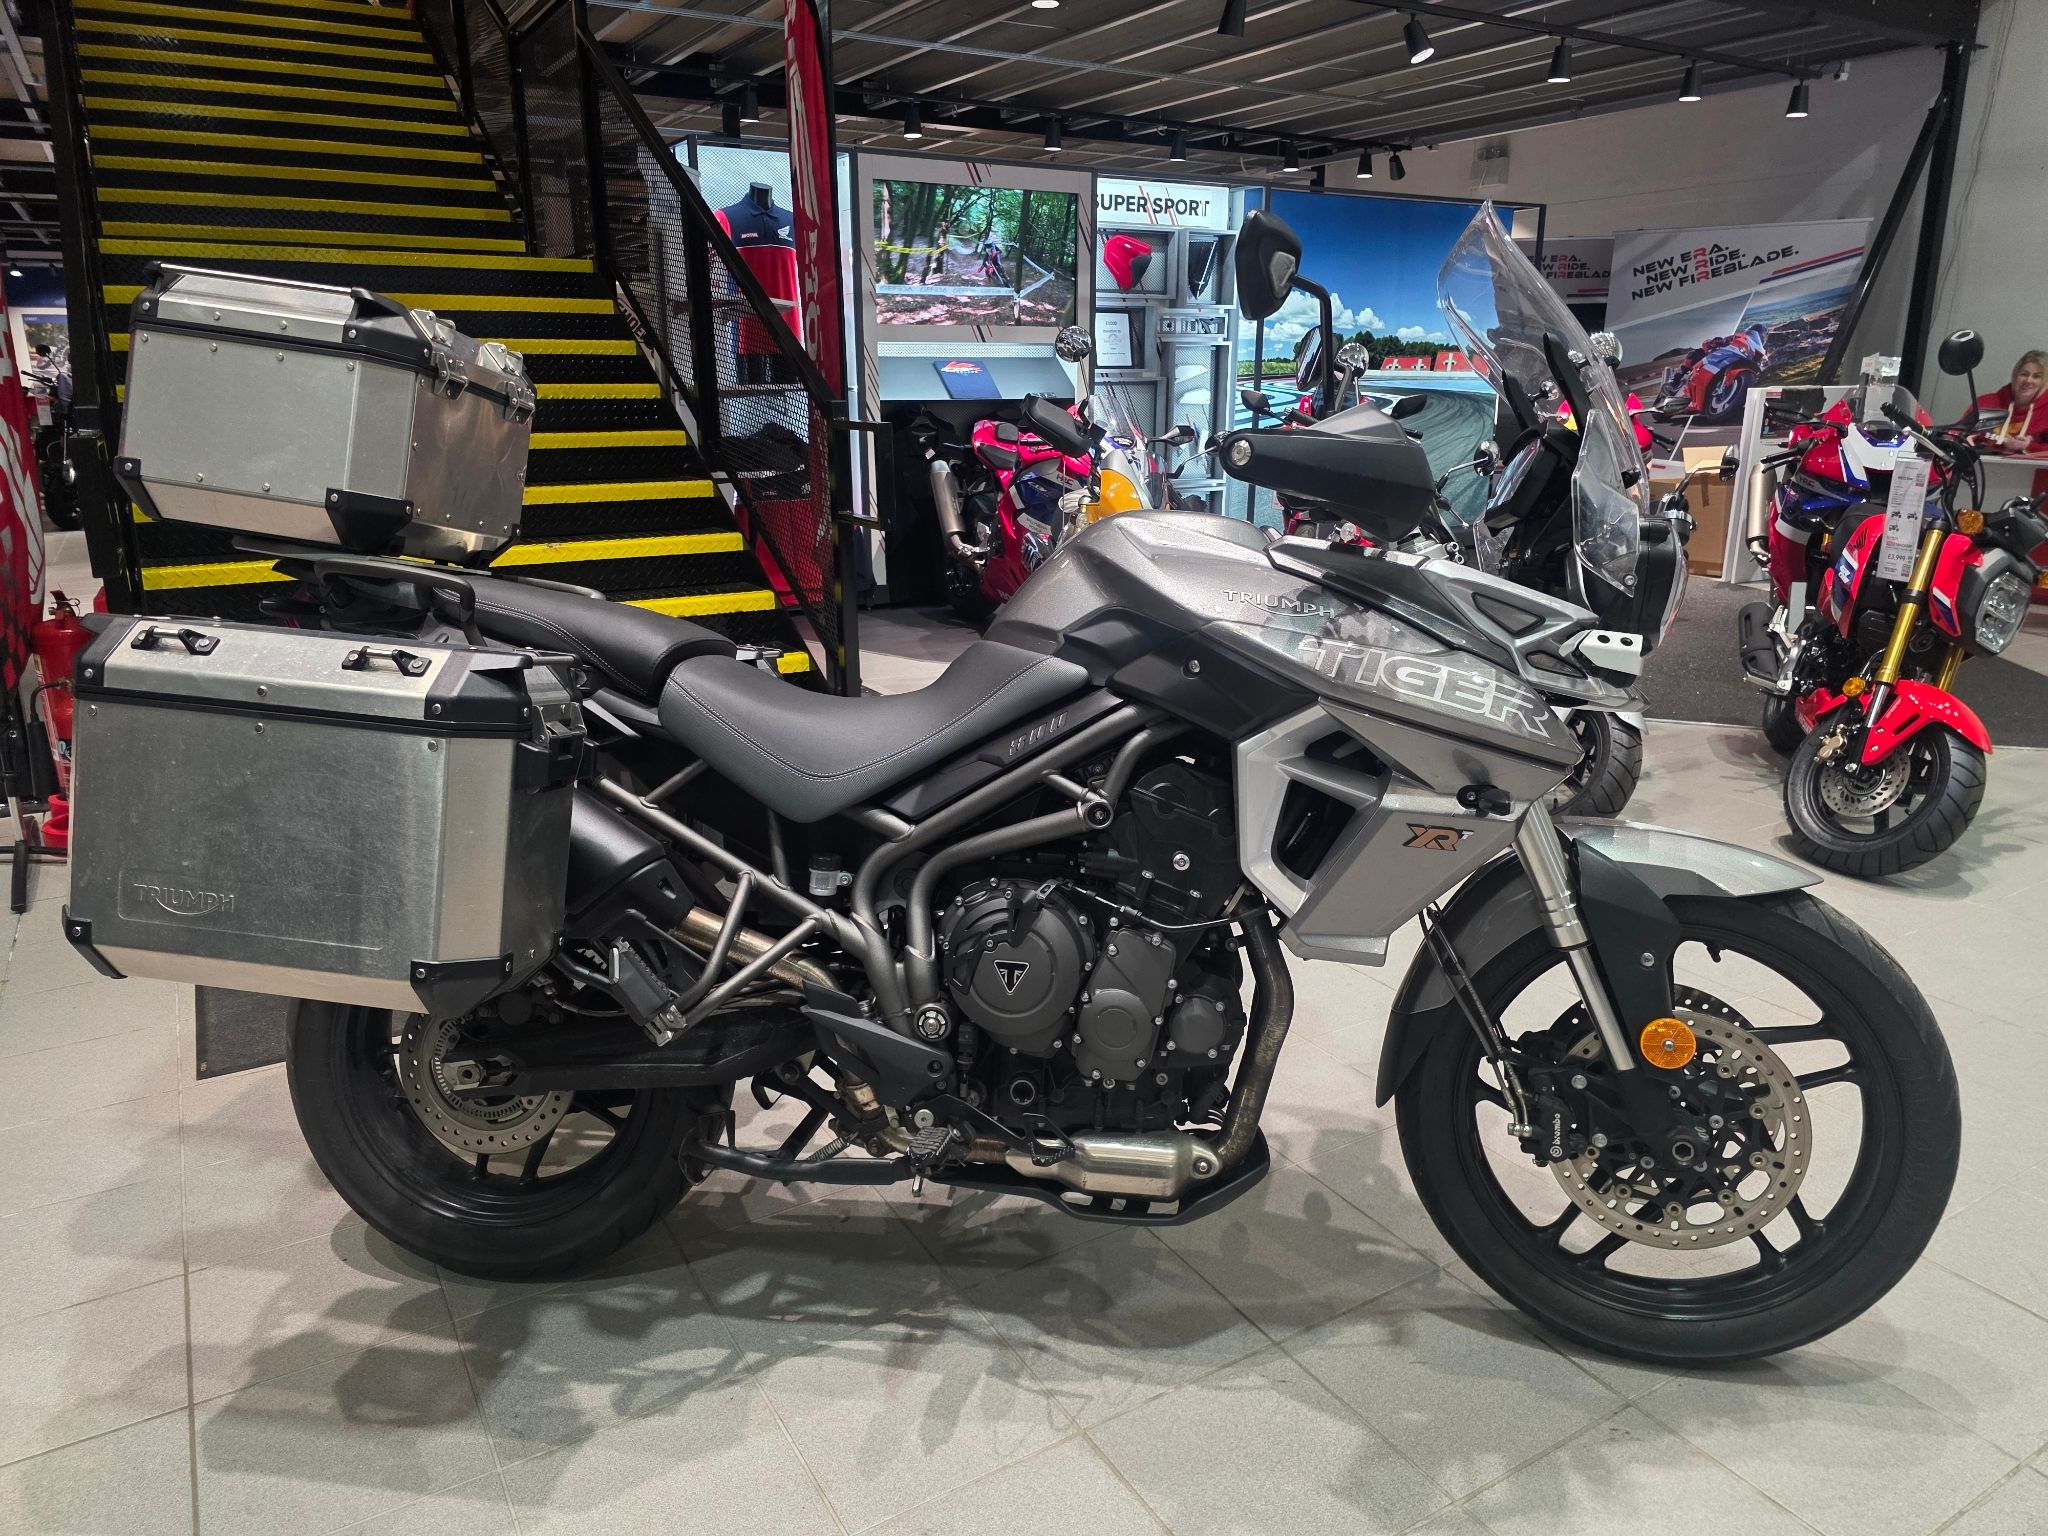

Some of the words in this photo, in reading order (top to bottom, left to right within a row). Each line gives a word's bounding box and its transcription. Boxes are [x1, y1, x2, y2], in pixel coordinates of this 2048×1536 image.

[1152, 198, 1210, 217] SPORT
[1546, 270, 1610, 279] FIREBLAD
[1631, 280, 1673, 300] NEW
[1679, 245, 1799, 287] FIREBLADE.
[1633, 256, 1675, 277] NEW
[1680, 243, 1729, 264] ERA.
[1646, 264, 1688, 285] NEW
[1695, 248, 1746, 271] RIDE.
[1223, 589, 1335, 619] TRIUMPH
[1298, 635, 1551, 738] TIGER
[1009, 711, 1068, 755] 800
[133, 883, 235, 914] TRIUMPH
[1552, 1113, 1561, 1145] brembo
